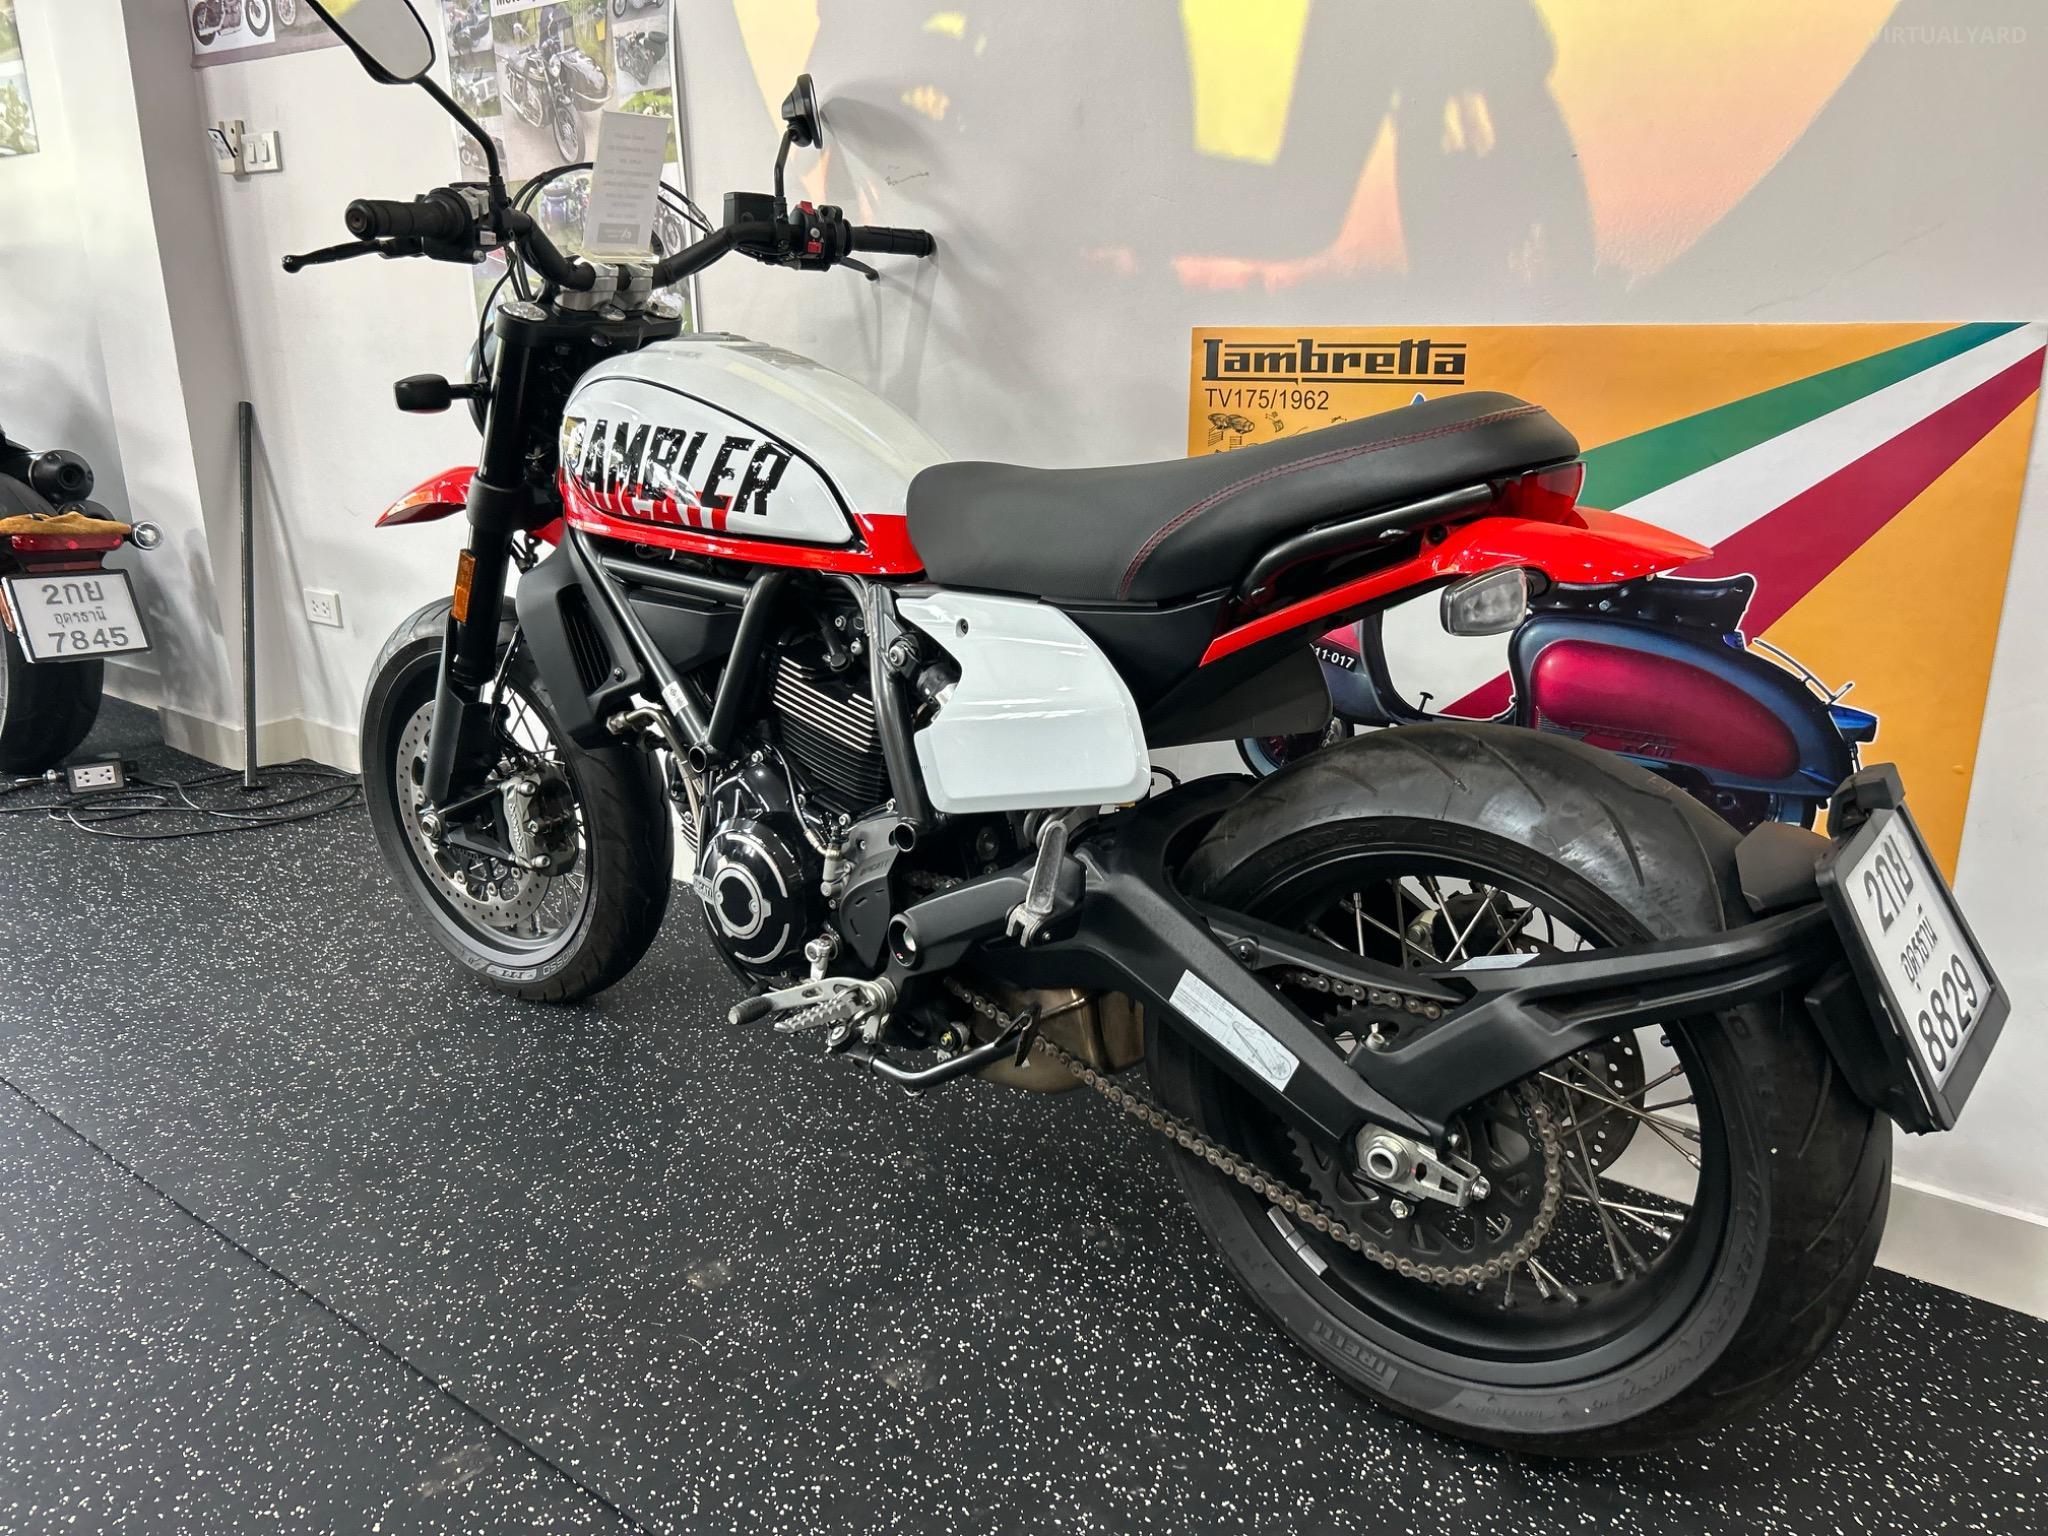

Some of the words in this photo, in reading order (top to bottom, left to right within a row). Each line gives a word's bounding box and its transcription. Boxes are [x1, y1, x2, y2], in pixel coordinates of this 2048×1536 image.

[1202, 339, 1467, 385] Lambretta
[1205, 388, 1329, 410] TV175/1962
[42, 581, 104, 605] 2กย
[54, 606, 107, 628] อุดรธานี
[48, 627, 129, 653] 7845
[1864, 835, 1914, 934] 2กย
[1900, 904, 1938, 992] อุดรธานี
[1918, 954, 1977, 1071] 8829
